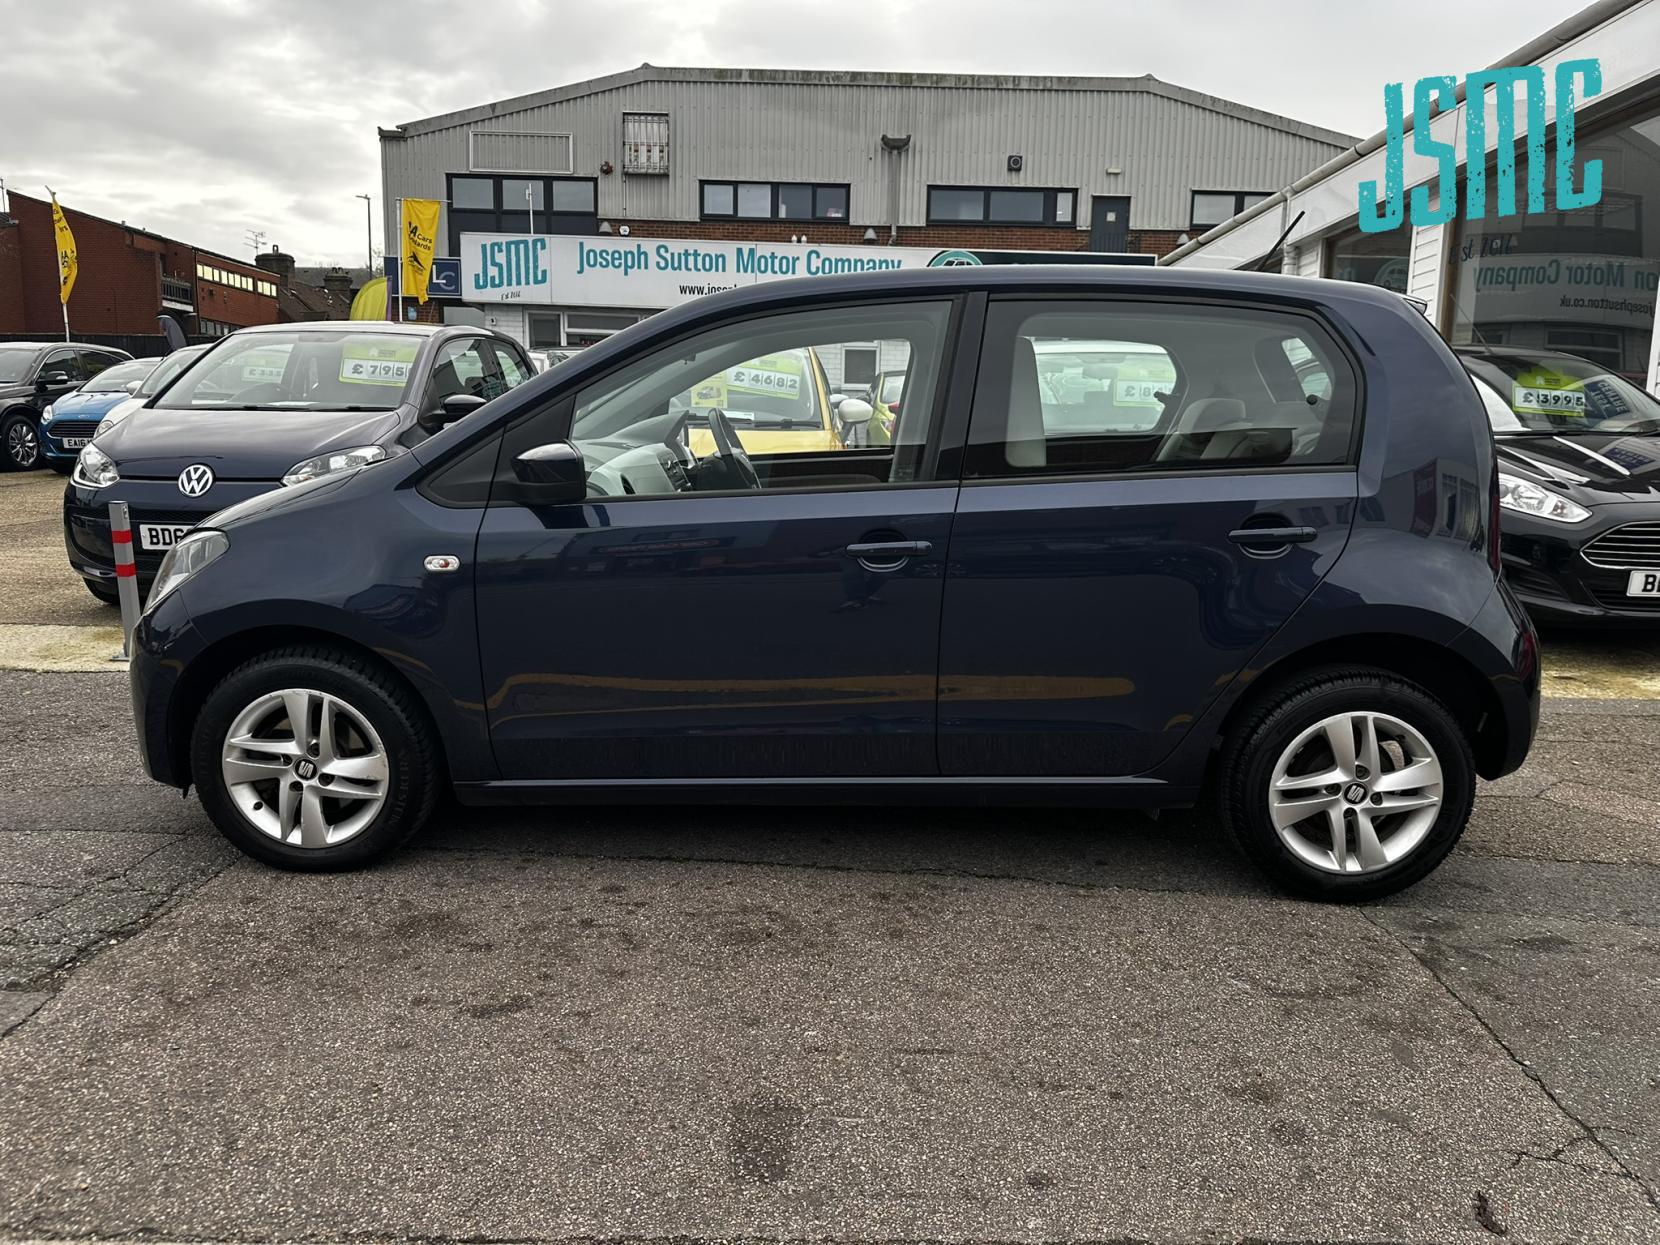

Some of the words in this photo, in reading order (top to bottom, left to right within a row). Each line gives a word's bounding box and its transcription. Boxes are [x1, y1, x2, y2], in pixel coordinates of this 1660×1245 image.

[416, 232, 433, 244] Cars
[474, 238, 548, 290] JSMC
[577, 242, 649, 276] Joseph
[655, 244, 727, 273] Sutton
[735, 248, 800, 275] Motor
[734, 370, 798, 389] £4682
[67, 438, 86, 448] EA16
[147, 527, 193, 545] BD6
[1641, 573, 1660, 593] B
